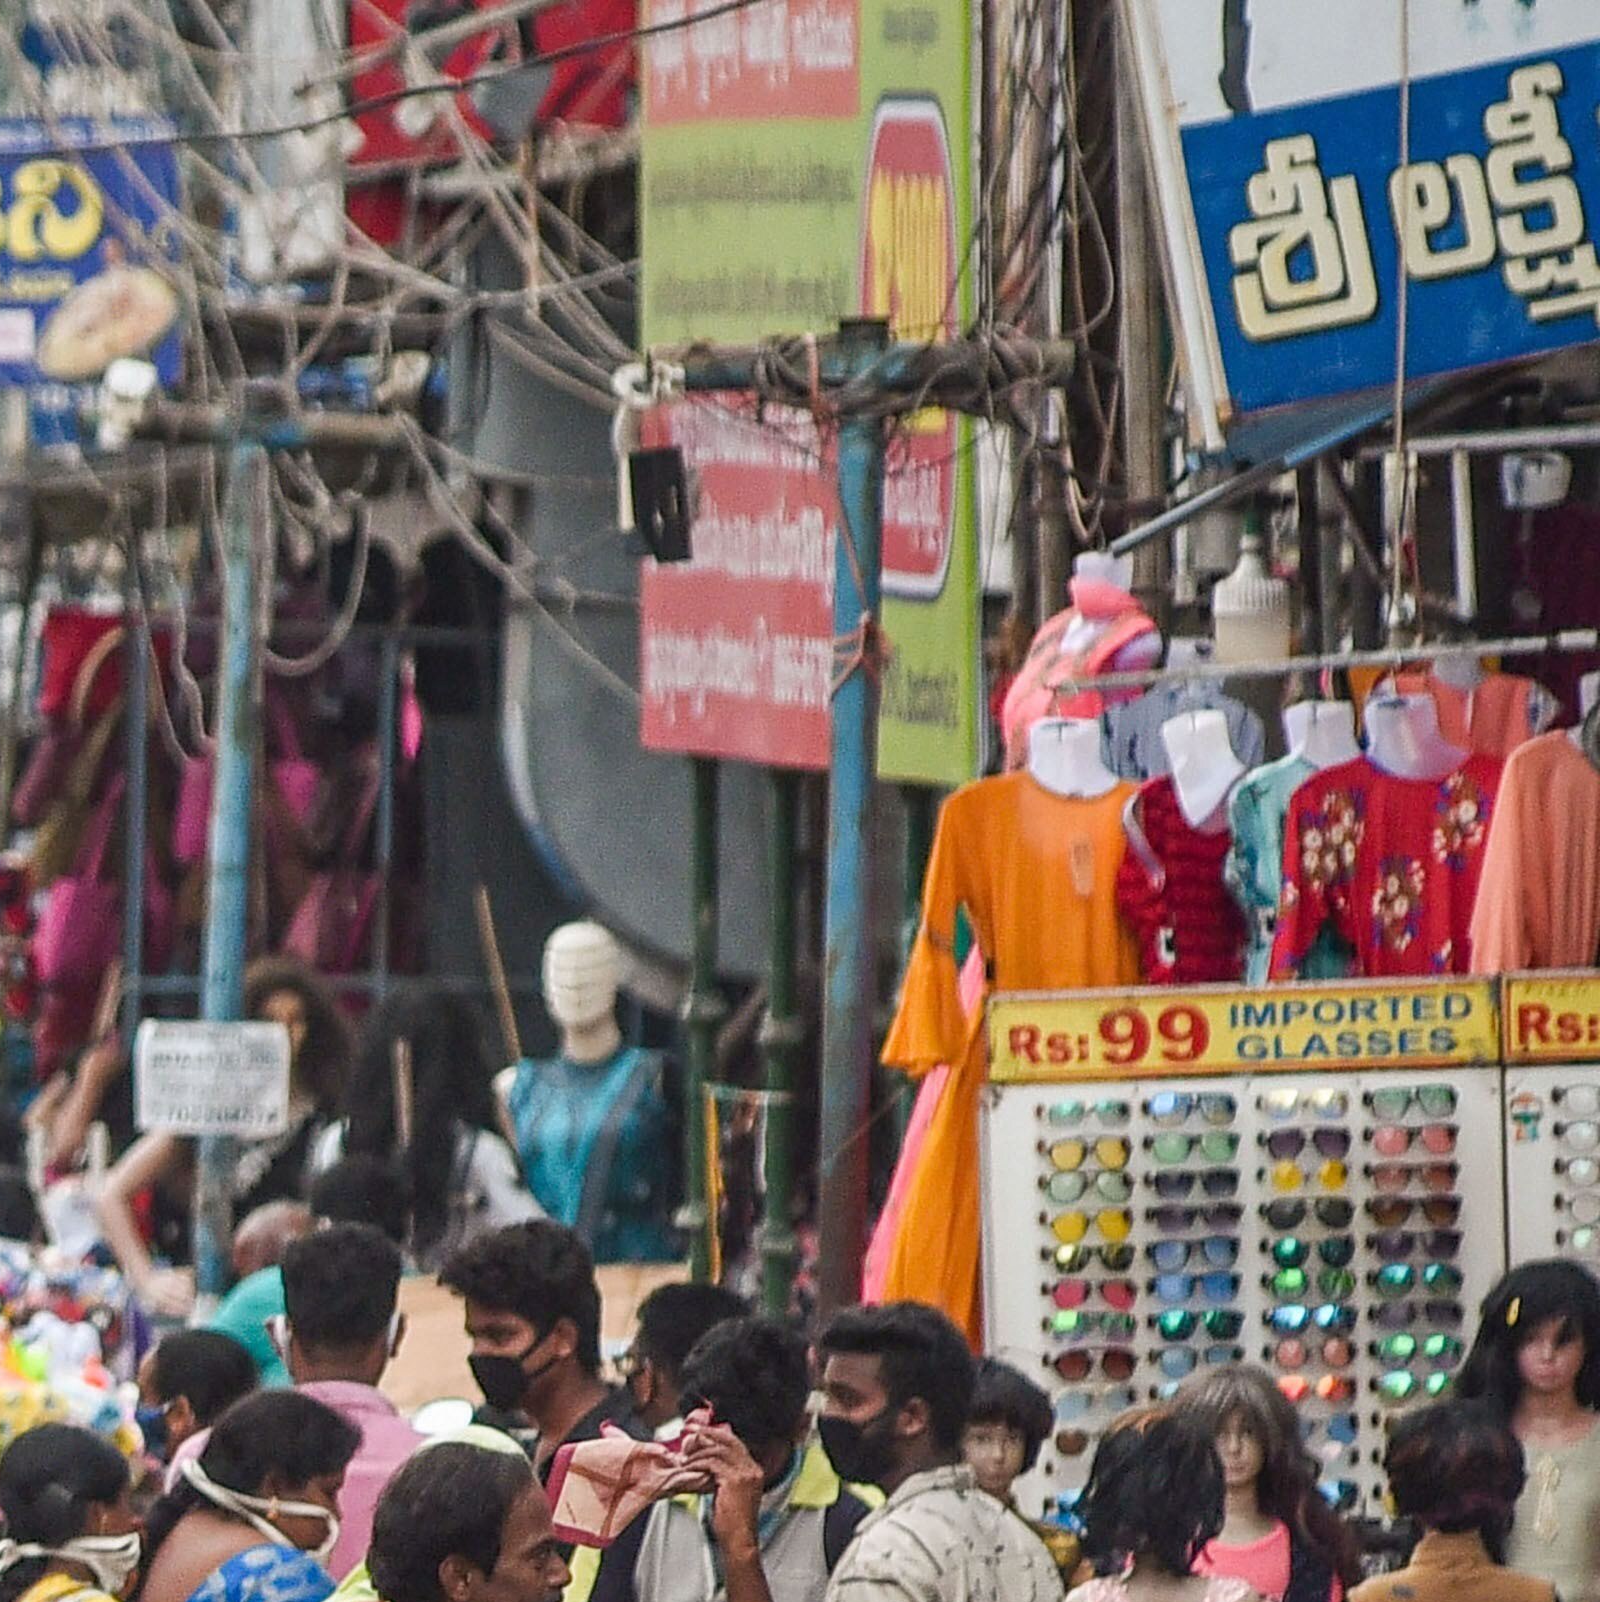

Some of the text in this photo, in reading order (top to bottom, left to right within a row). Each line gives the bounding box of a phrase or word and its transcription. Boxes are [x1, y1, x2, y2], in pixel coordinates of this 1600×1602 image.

[1230, 133, 1378, 342] శ్రీ
[1230, 992, 1472, 1028] IMPORTED
[1236, 1027, 1458, 1060] GLASSES
